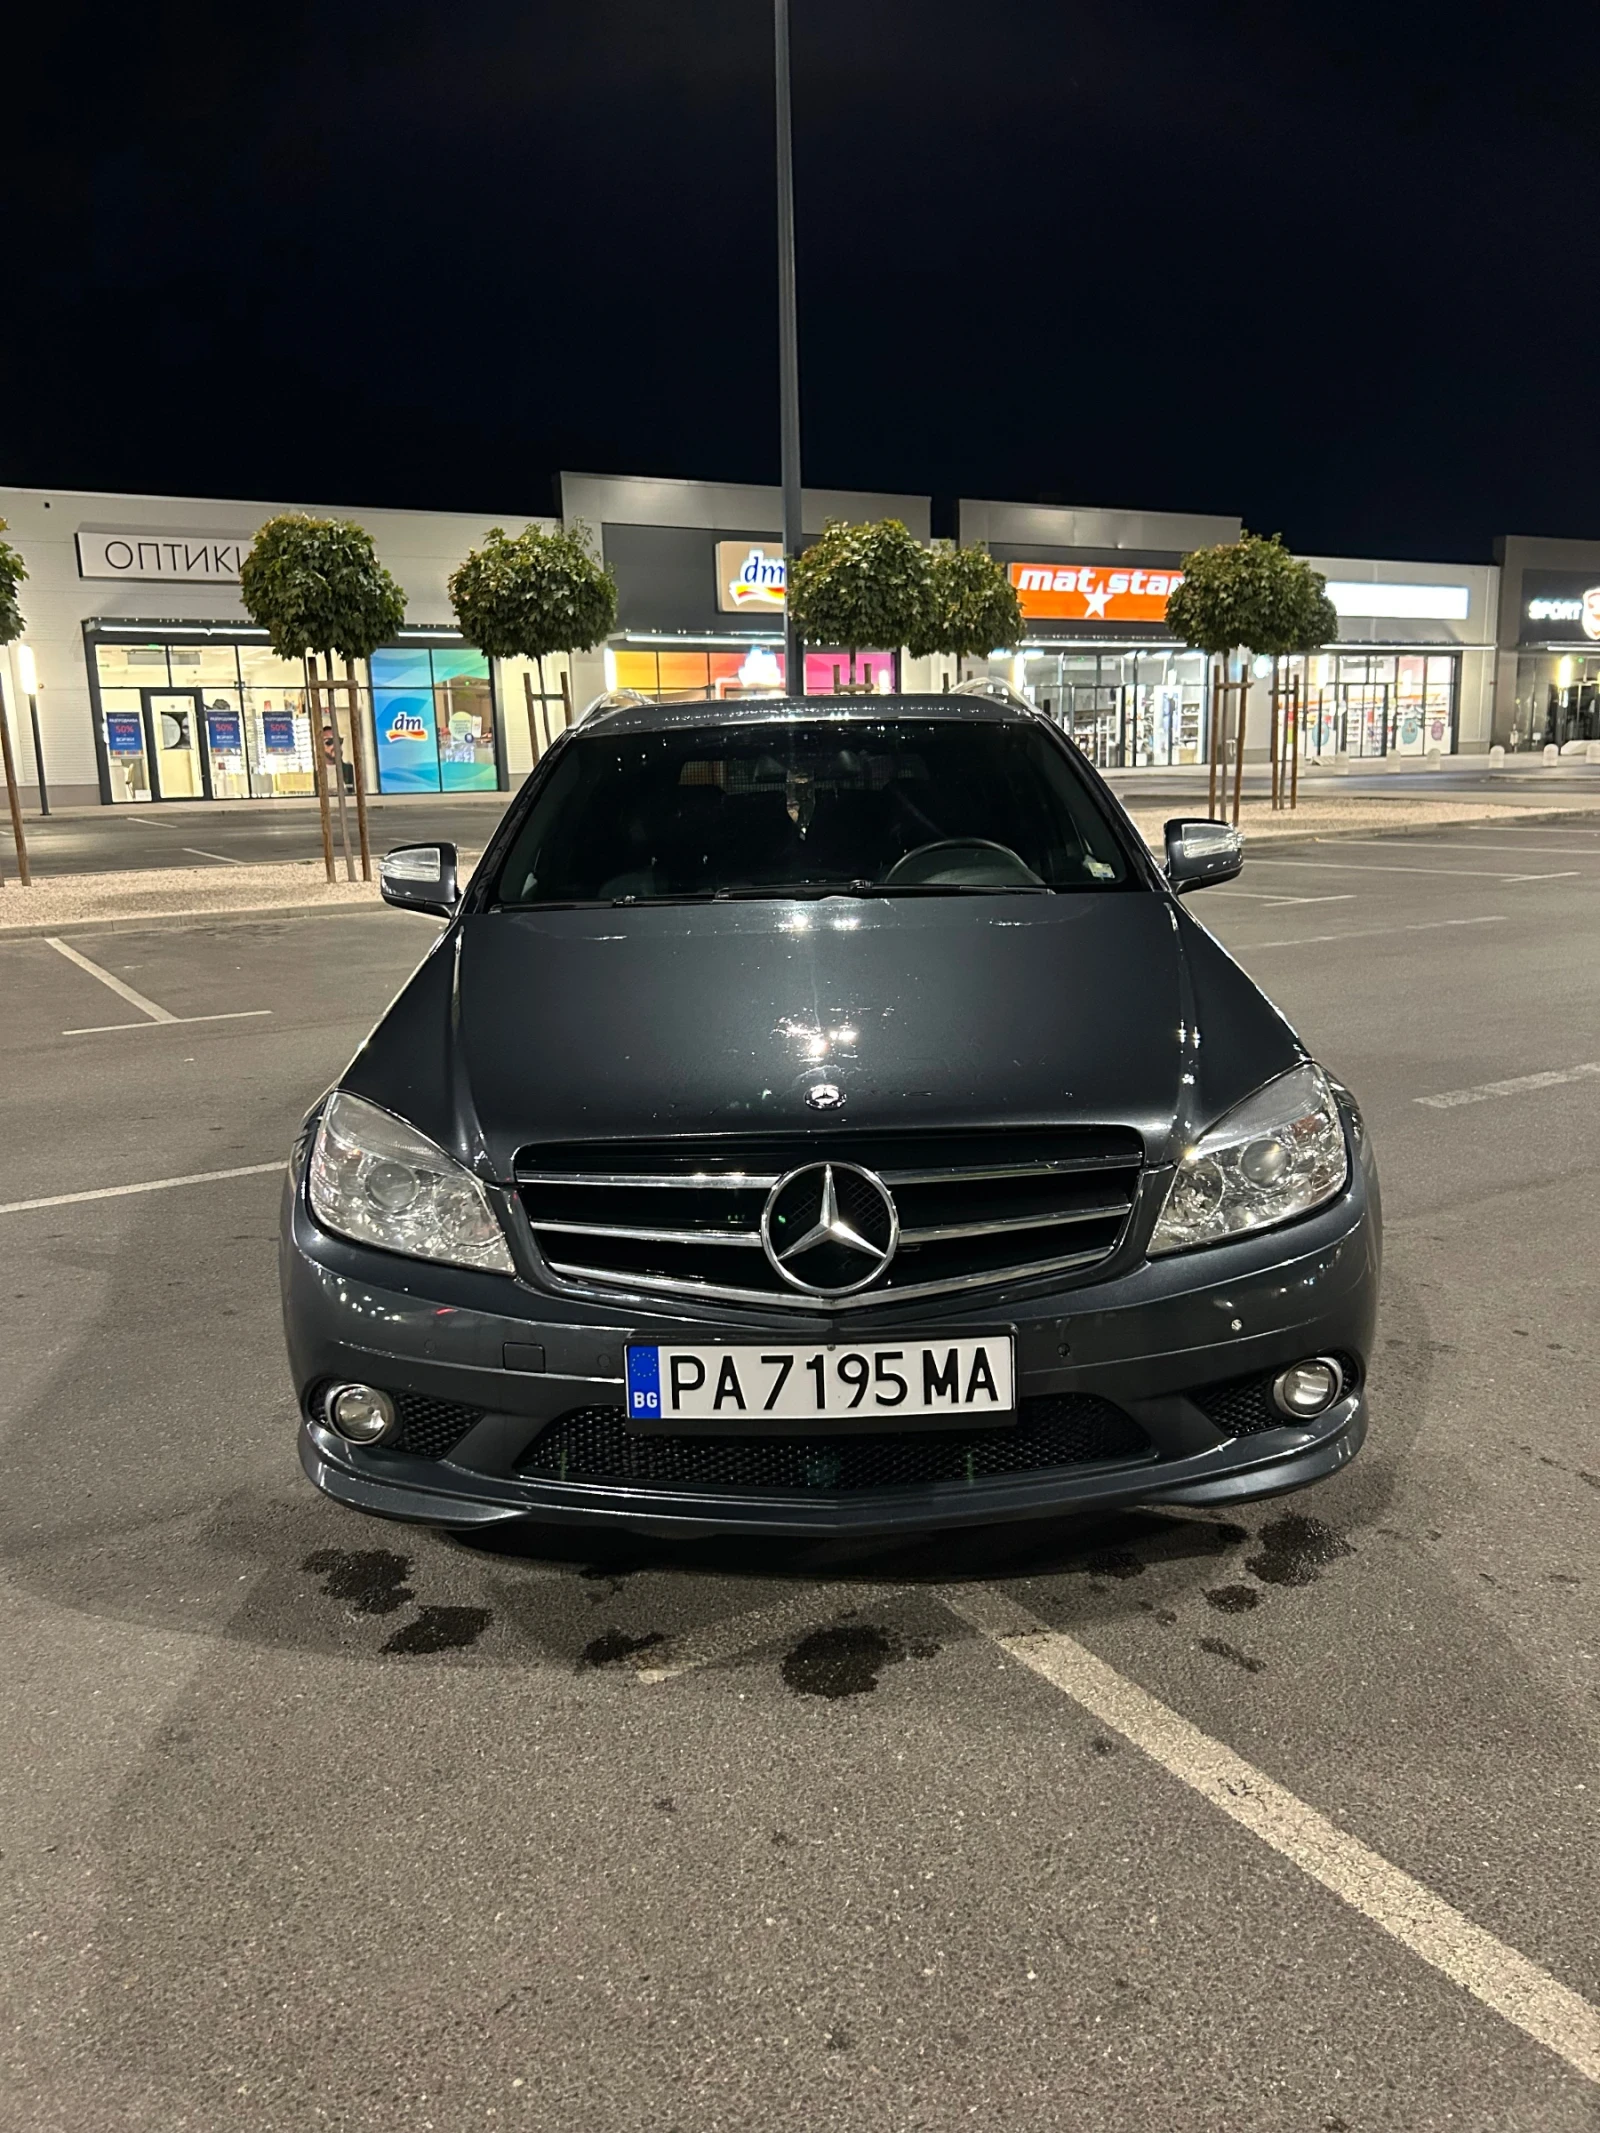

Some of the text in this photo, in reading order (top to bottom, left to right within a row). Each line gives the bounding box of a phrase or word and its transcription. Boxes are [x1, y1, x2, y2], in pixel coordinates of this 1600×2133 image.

[744, 556, 785, 584] dm
[1018, 567, 1096, 593] mat
[1528, 599, 1583, 620] SPORT
[115, 725, 134, 733] 50%
[215, 723, 233, 731] 50%
[394, 714, 421, 730] dm
[634, 1392, 657, 1408] BG
